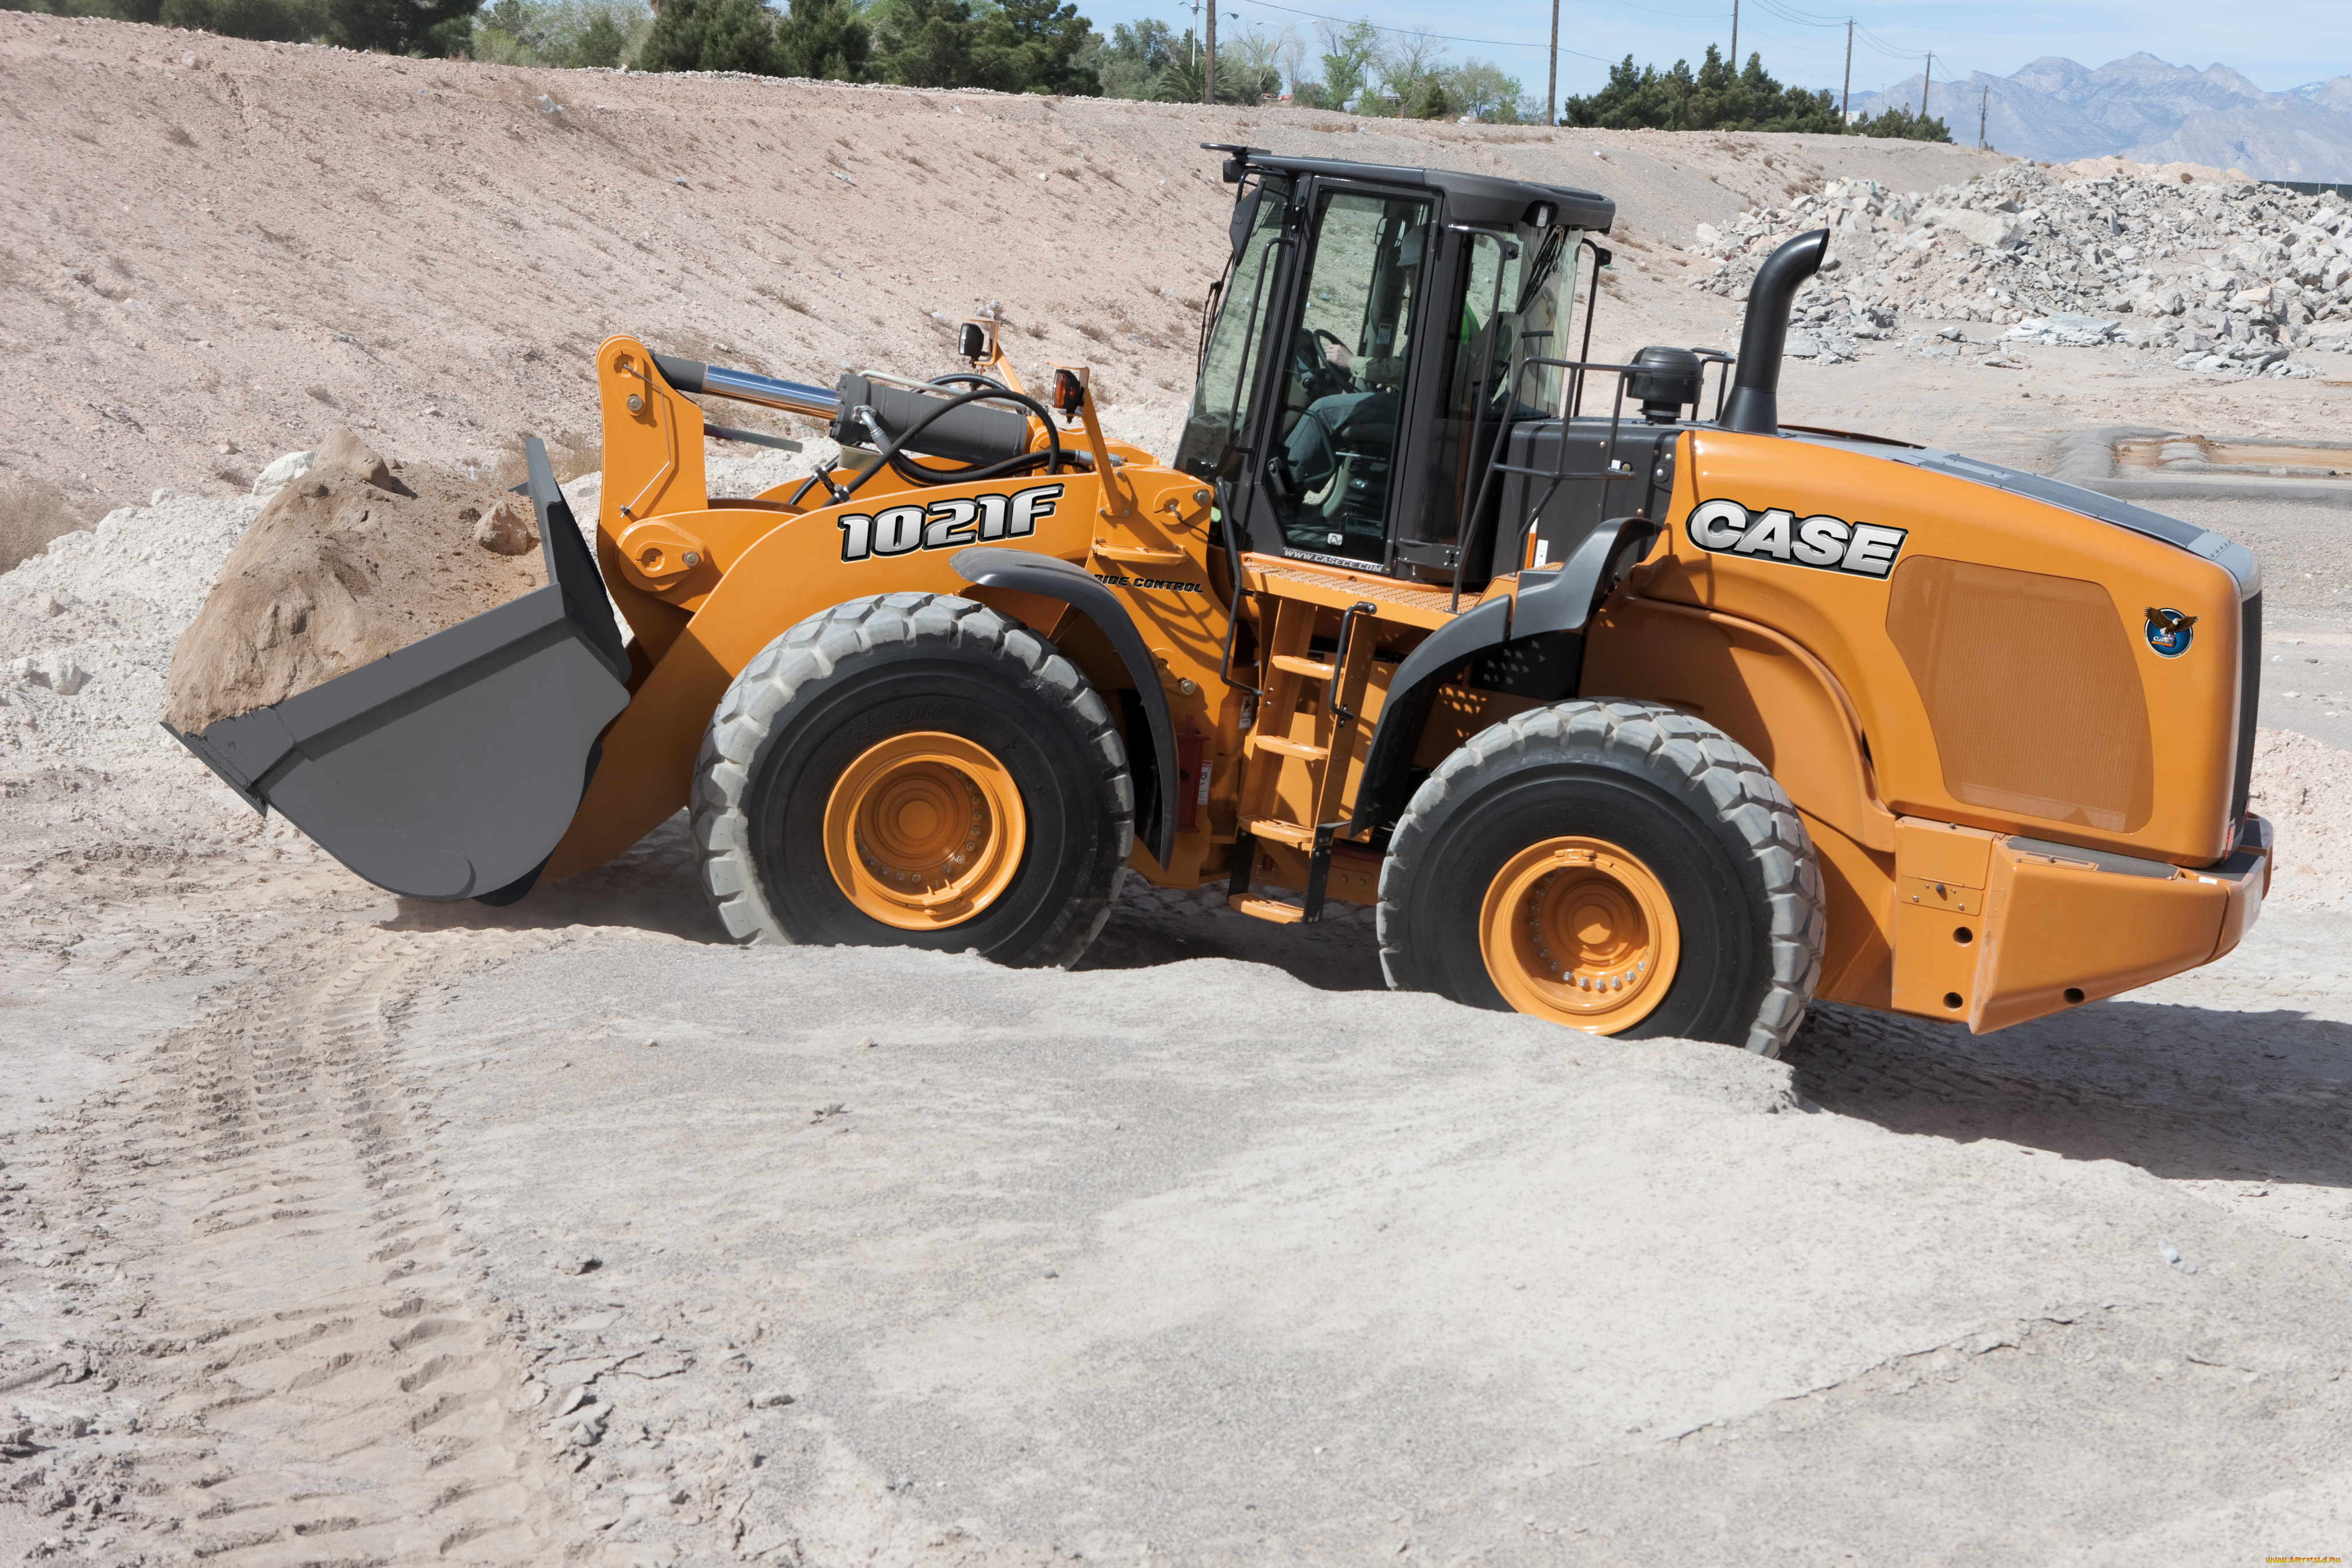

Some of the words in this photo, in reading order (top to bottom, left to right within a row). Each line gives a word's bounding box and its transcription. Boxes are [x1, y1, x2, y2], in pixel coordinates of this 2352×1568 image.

[838, 483, 1065, 563] 1021F
[1284, 549, 1384, 572] WWW.CASECE.COM
[1686, 499, 1908, 579] CASE
[1133, 578, 1204, 593] CONTROL
[798, 702, 949, 799] BRIDGESTONE
